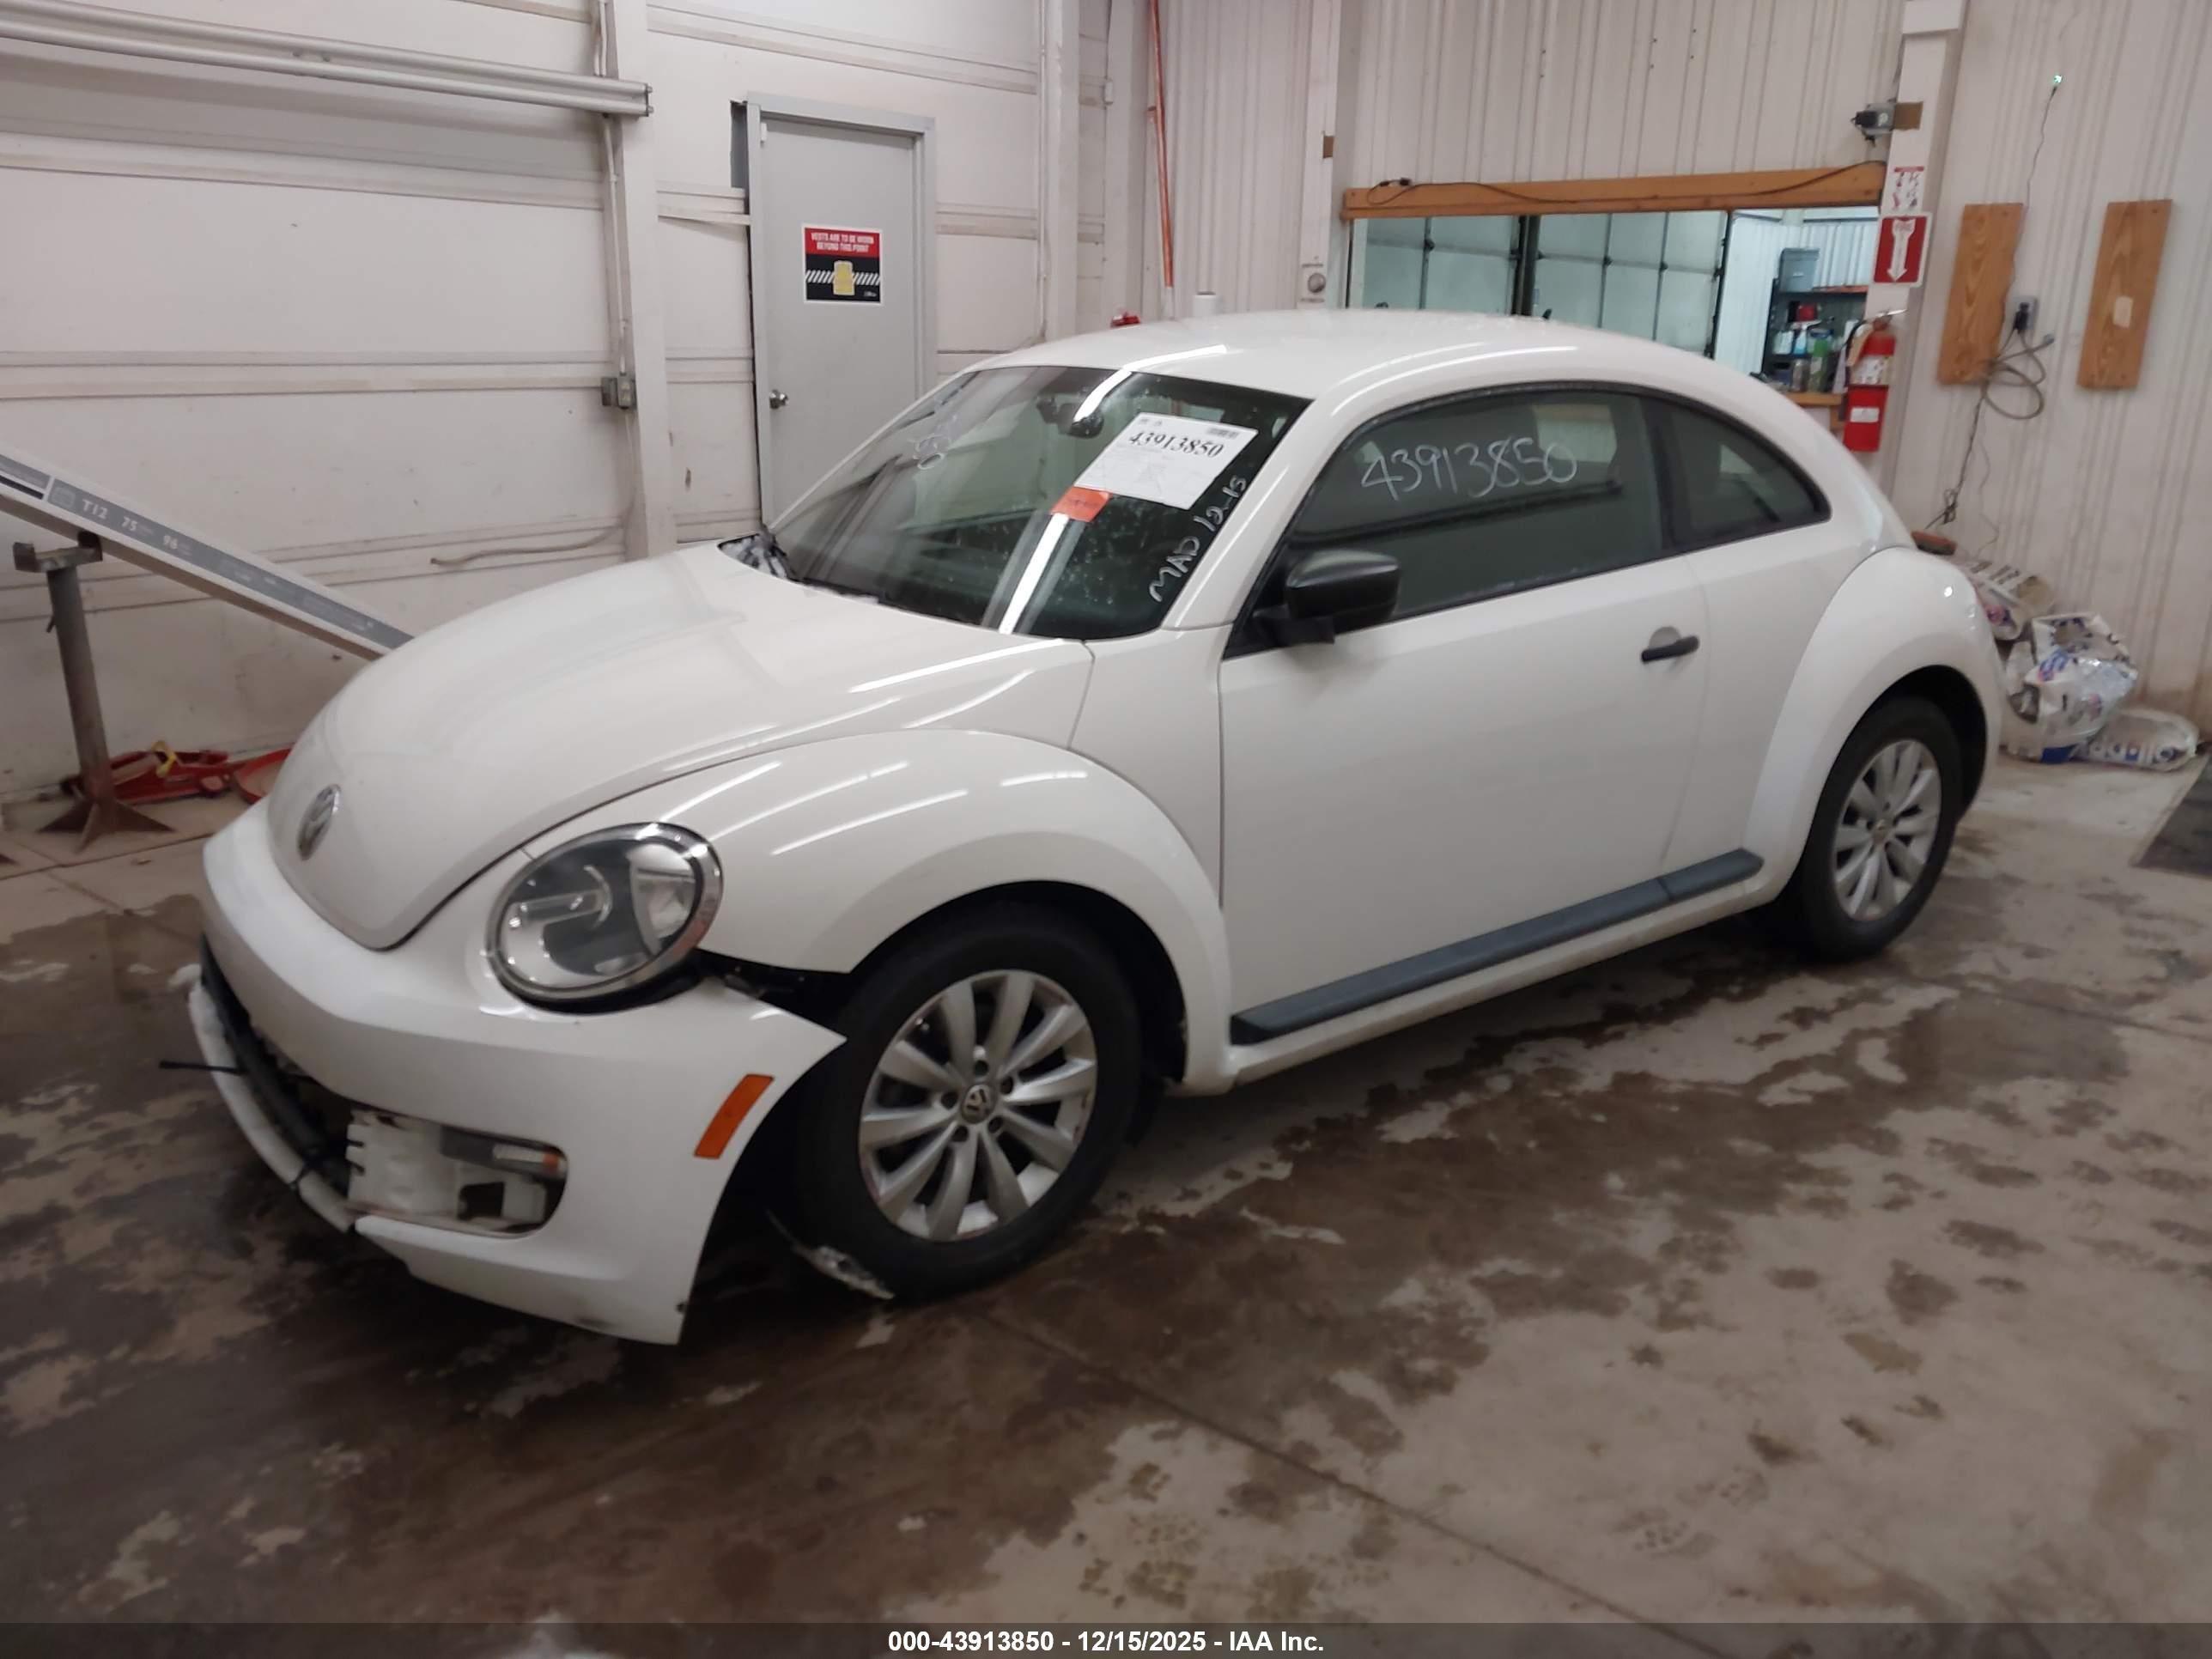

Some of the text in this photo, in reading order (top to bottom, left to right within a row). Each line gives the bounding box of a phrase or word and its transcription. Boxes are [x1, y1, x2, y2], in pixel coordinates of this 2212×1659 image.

[1129, 431, 1224, 458] 43913850
[1361, 436, 1577, 501] 43913850
[82, 499, 108, 520] T12
[121, 517, 138, 532] 75
[1149, 536, 1200, 602] MAD
